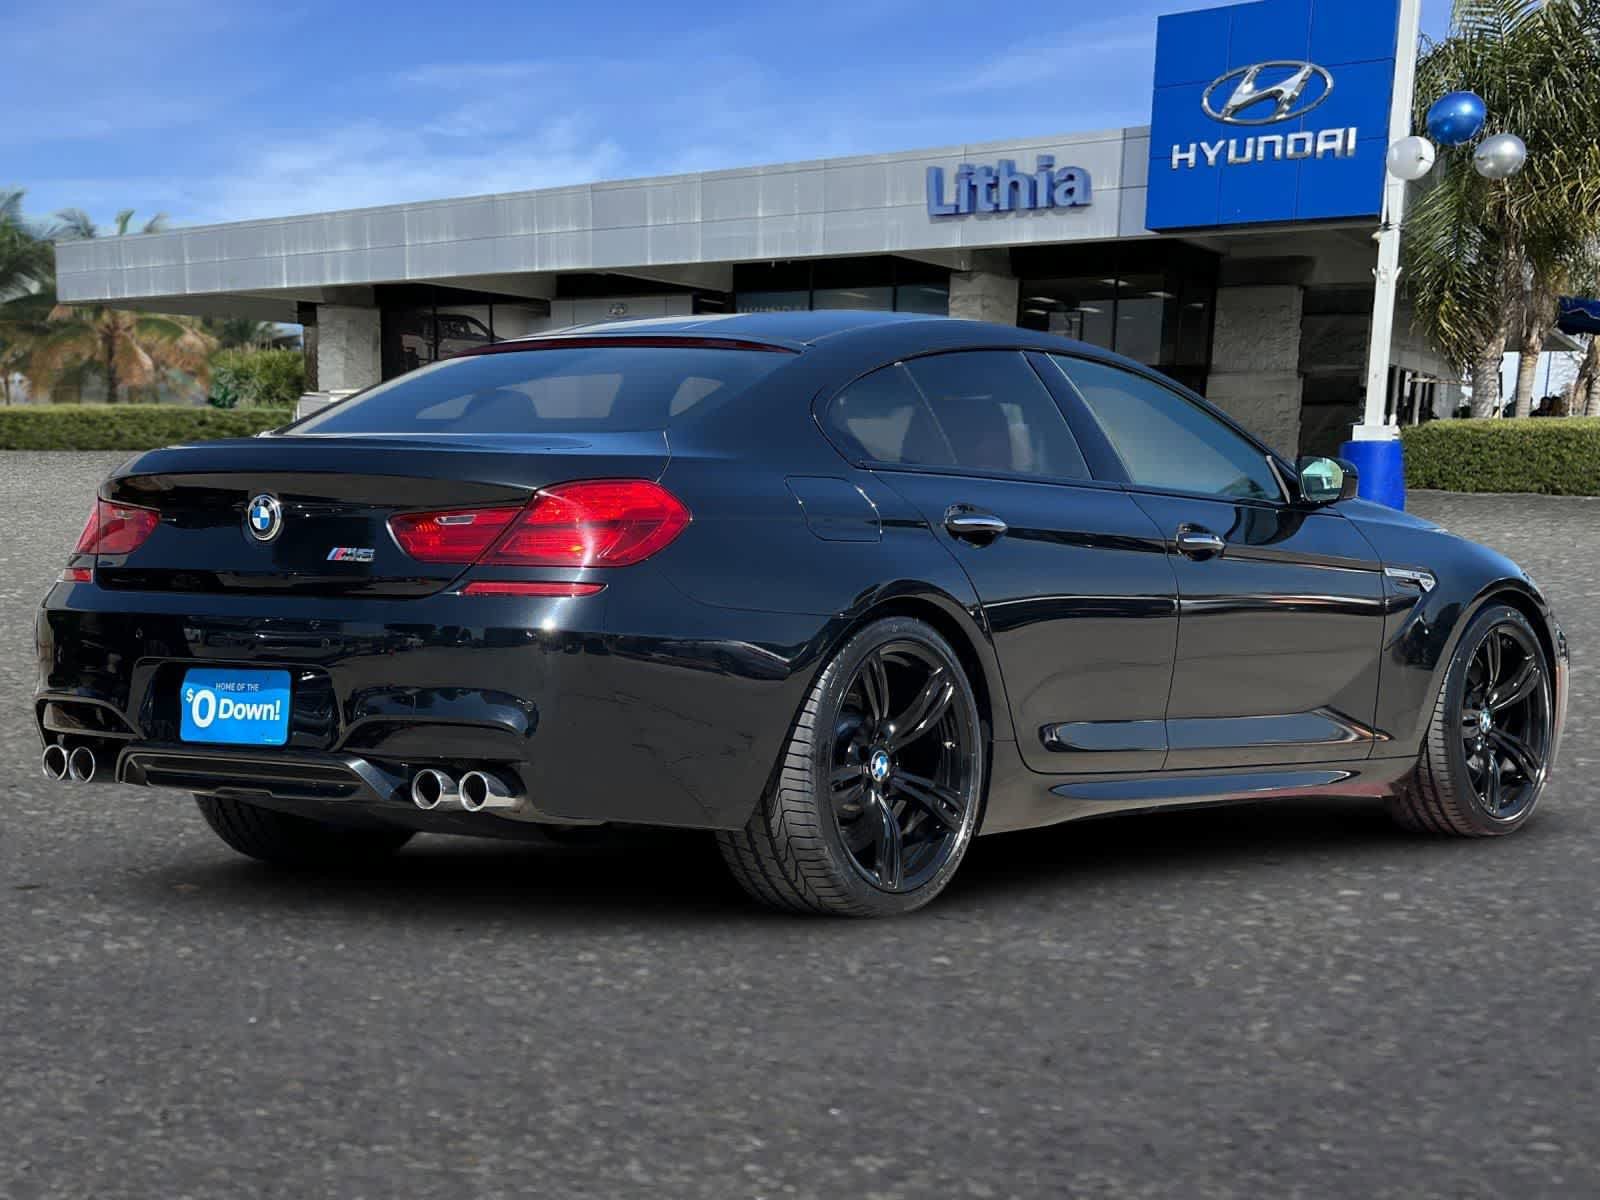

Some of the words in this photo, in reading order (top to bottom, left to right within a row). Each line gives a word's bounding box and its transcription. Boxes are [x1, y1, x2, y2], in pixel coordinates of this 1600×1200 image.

[1171, 127, 1358, 169] HYUNDAI
[926, 154, 1093, 216] Lithia
[215, 682, 235, 692] HOME
[236, 682, 246, 692] OF
[247, 683, 260, 692] THE
[218, 698, 281, 721] Down!
